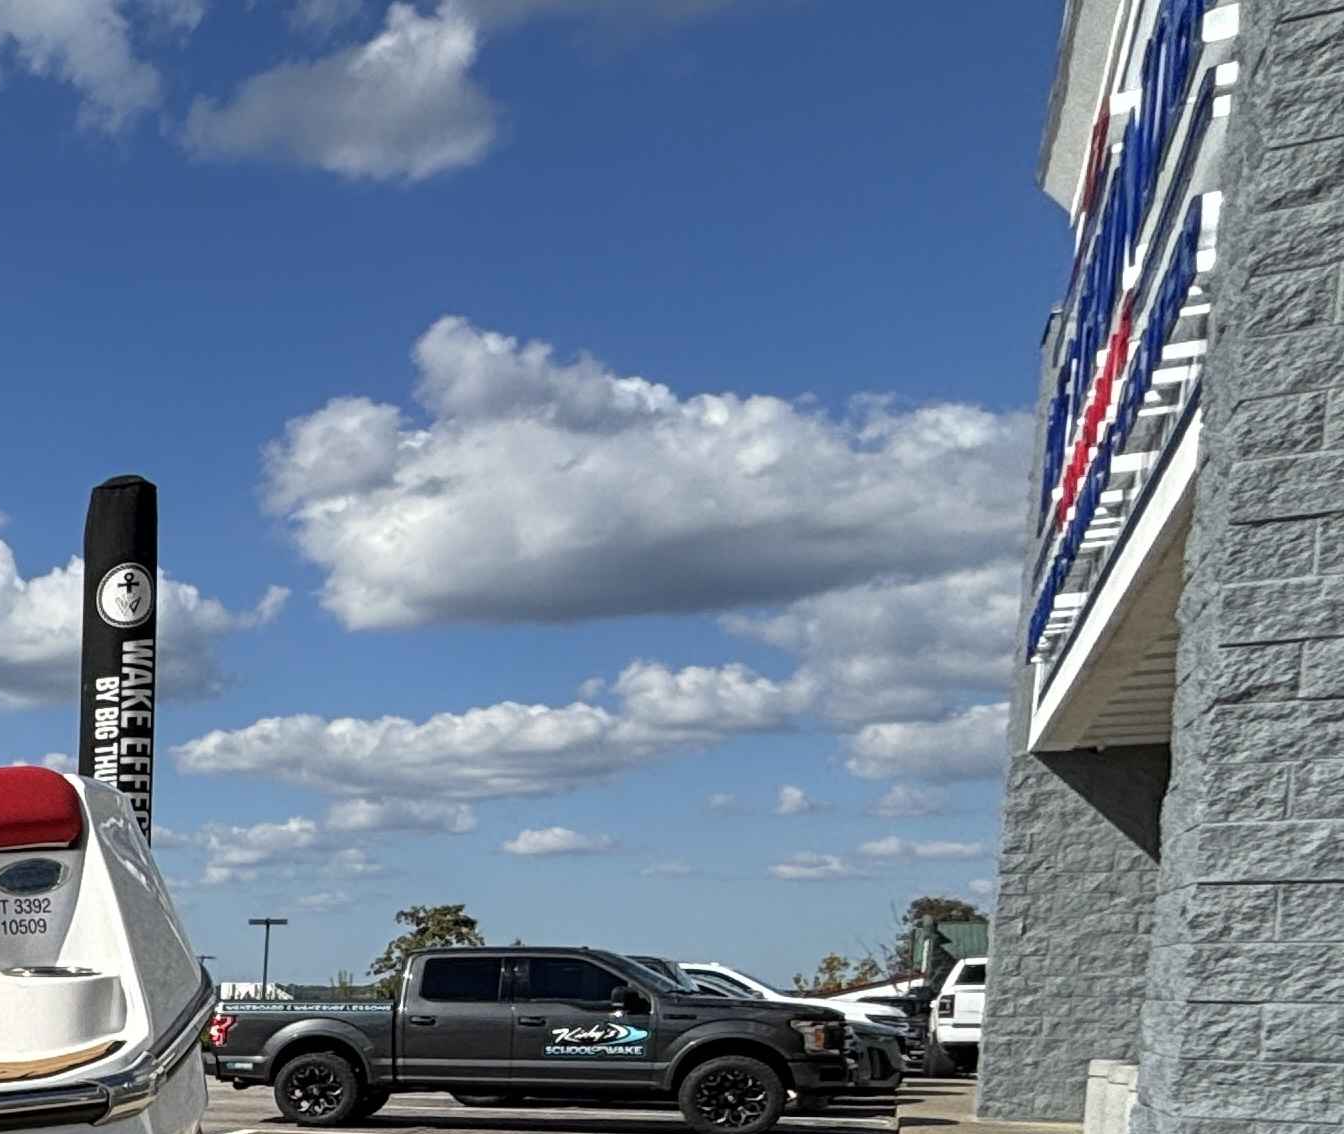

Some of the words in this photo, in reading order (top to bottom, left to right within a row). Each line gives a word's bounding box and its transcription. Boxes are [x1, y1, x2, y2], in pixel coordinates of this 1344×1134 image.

[96, 676, 119, 701] BY
[120, 639, 153, 728] WAKE
[95, 706, 119, 740] BIG
[14, 897, 52, 915] 3392
[1, 918, 48, 936] 10509
